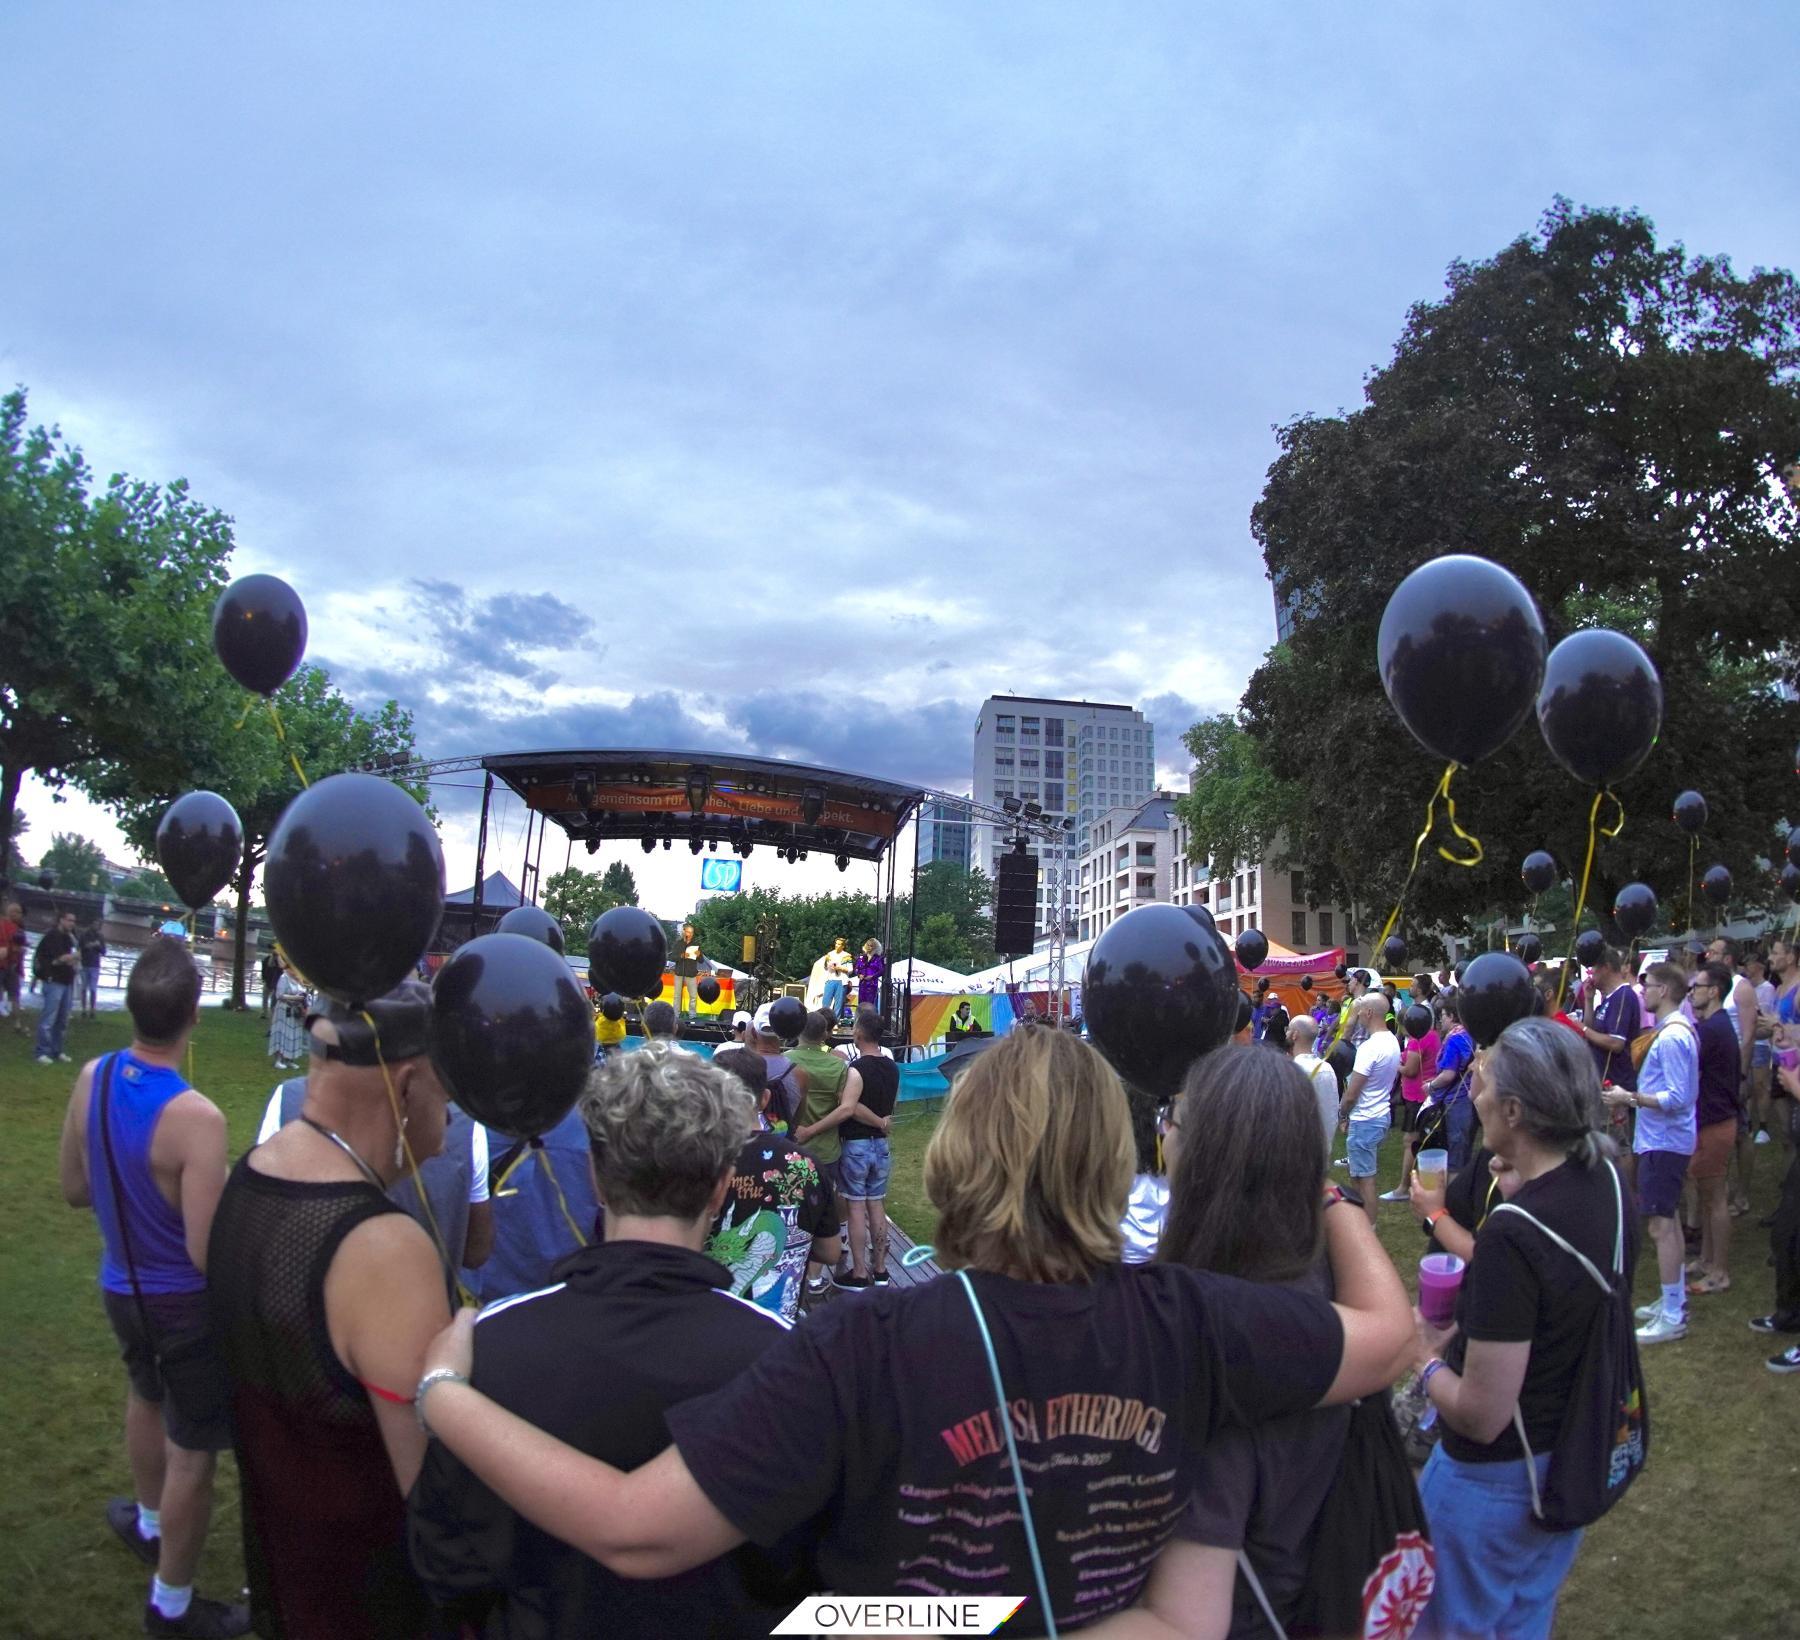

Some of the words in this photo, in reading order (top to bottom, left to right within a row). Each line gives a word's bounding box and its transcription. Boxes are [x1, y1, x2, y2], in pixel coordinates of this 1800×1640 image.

[739, 800, 772, 814] Liebe
[775, 805, 799, 817] und
[1045, 1393, 1167, 1454] ETHERIDGE
